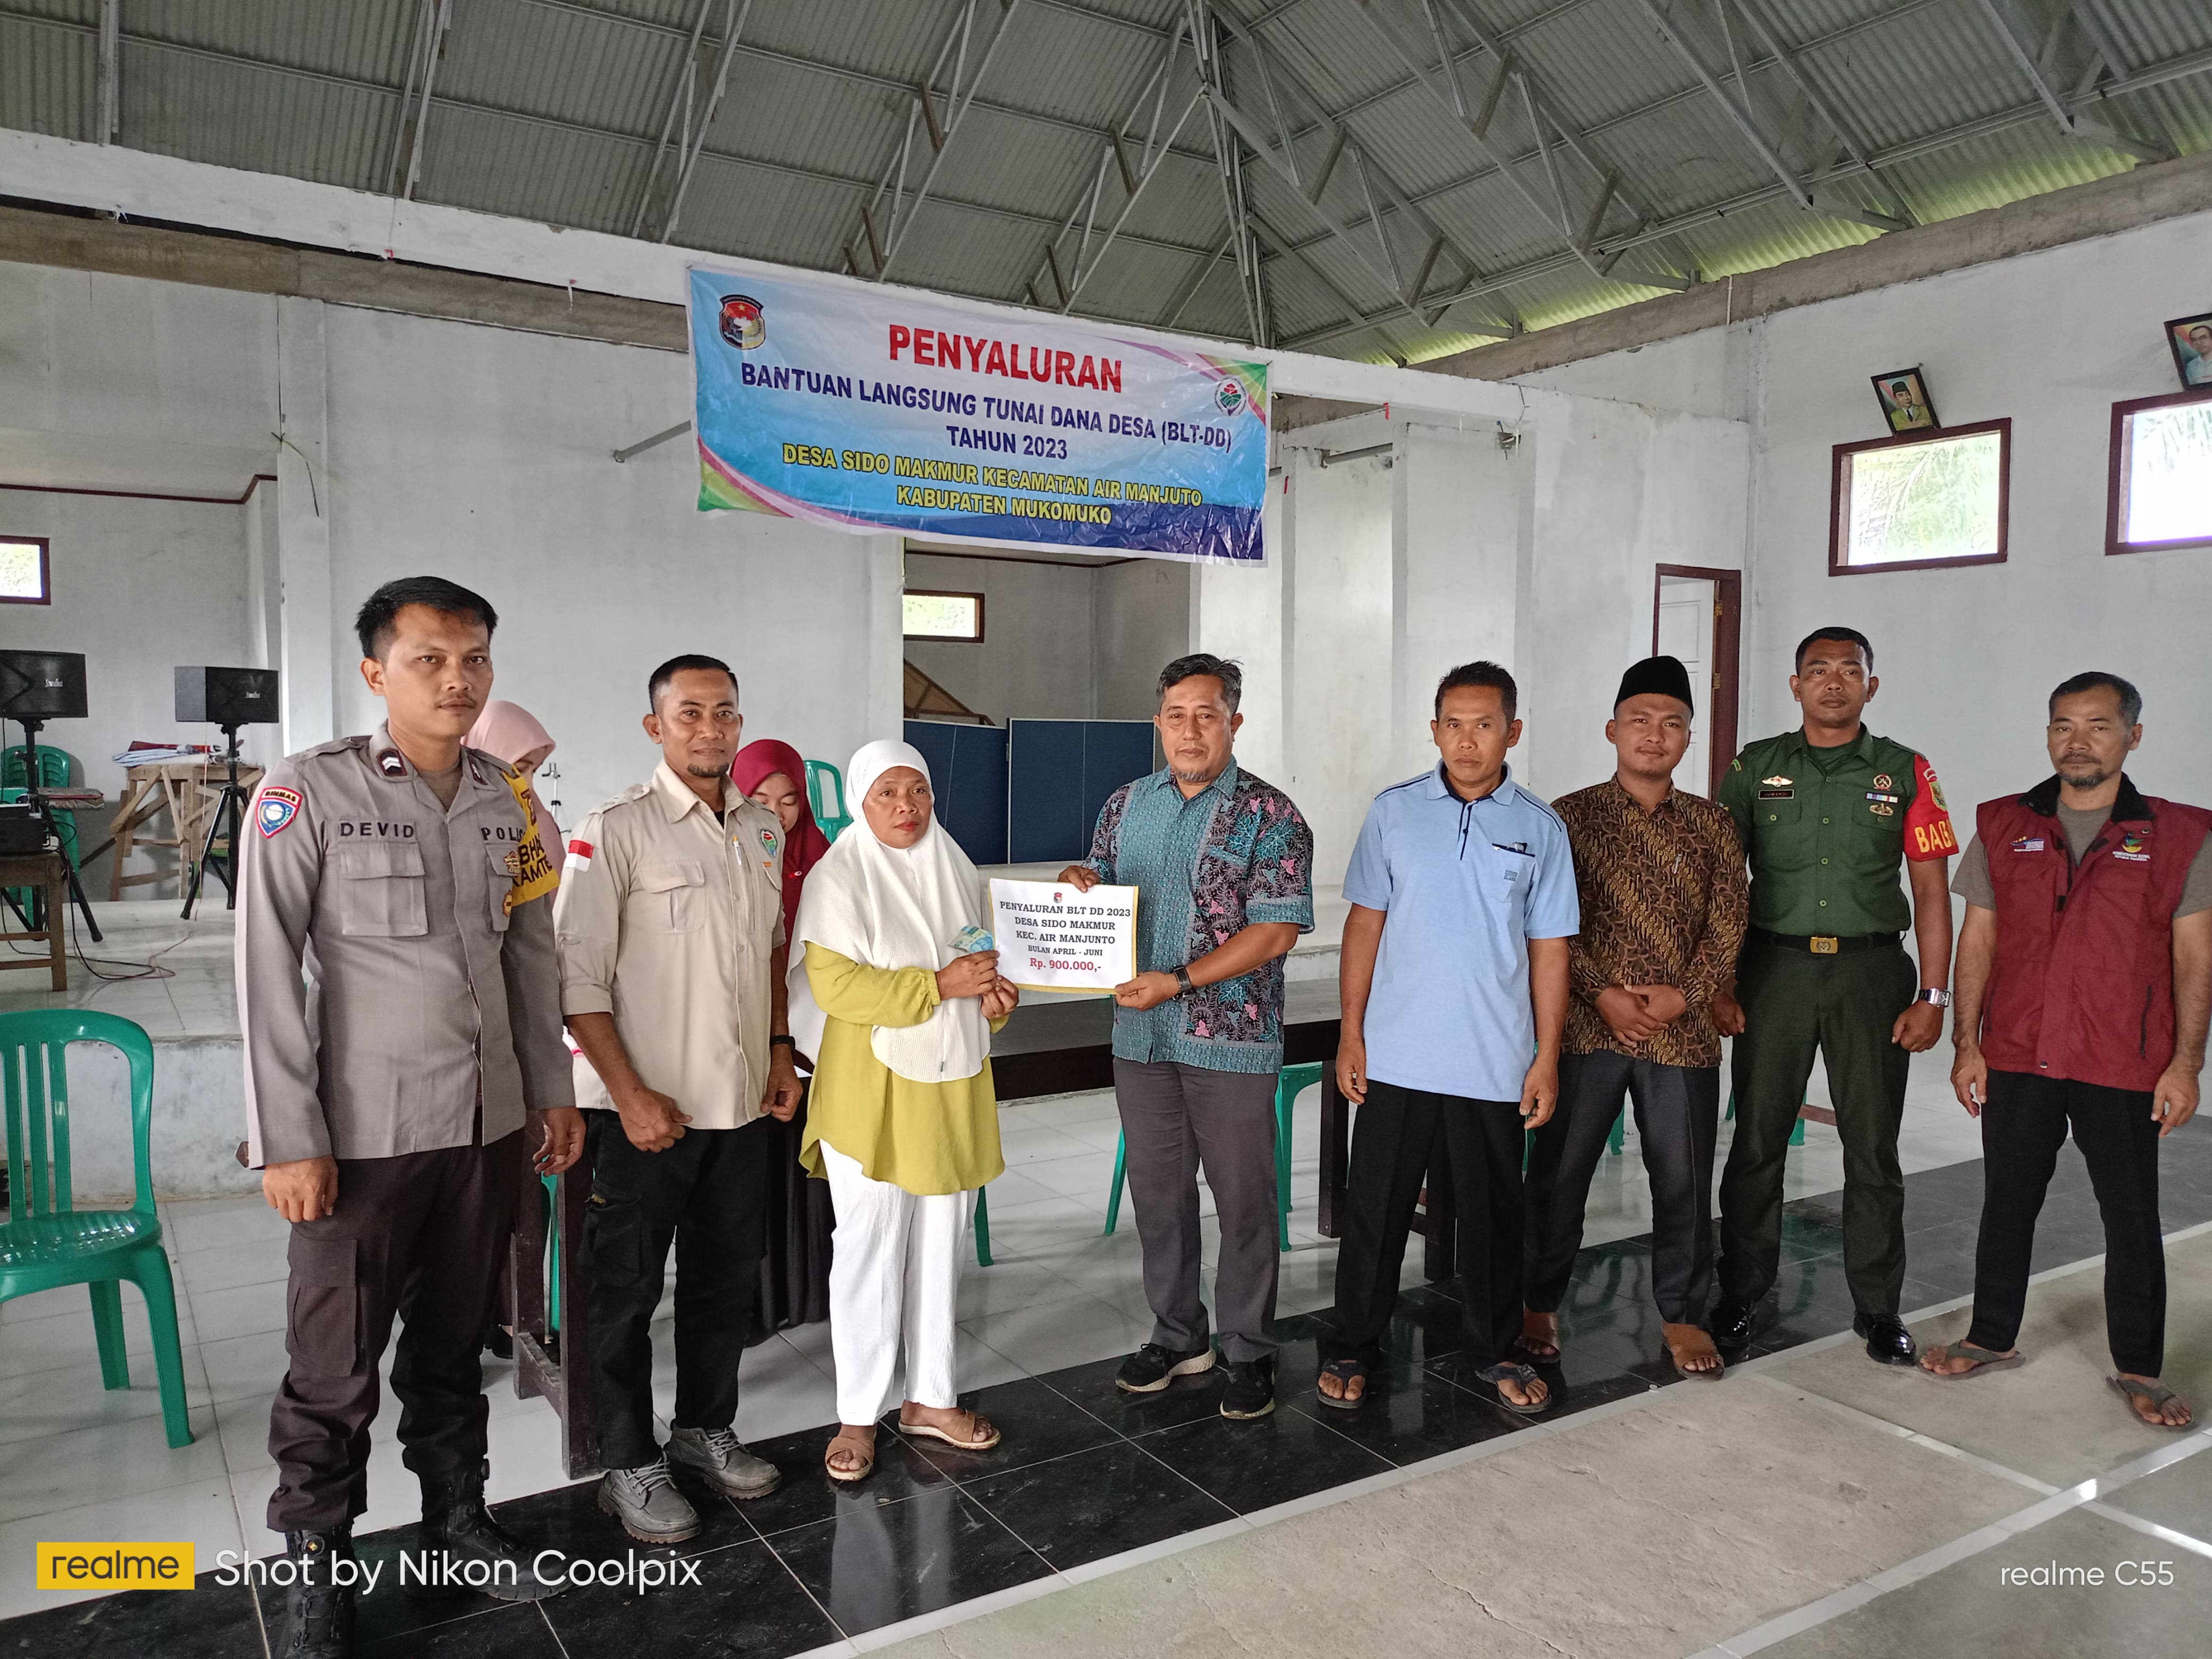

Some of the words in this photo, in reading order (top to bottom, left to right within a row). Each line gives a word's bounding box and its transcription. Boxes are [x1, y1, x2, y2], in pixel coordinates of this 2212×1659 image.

[890, 324, 1121, 393] PENYALURAN
[742, 363, 852, 398] BANTUAN
[859, 380, 976, 416] LANGSUNG
[984, 397, 1043, 424] TUNAI
[1051, 406, 1102, 432] DANA
[1109, 414, 1156, 438] DESA
[1161, 421, 1231, 453] (BLT-DD)
[946, 425, 1016, 453] TAHUN
[1023, 435, 1068, 459] 2023
[783, 443, 837, 468] DESA
[842, 450, 889, 474] SIDO
[895, 456, 978, 484] MAKMUR
[983, 467, 1088, 496] KECAMATAN
[1093, 479, 1121, 499] AIR
[1126, 483, 1203, 507] MANJUTO
[897, 485, 1007, 515] KABUPATEN
[1011, 498, 1112, 525] MUKOMUKO
[265, 791, 296, 802] BINMAS
[340, 823, 414, 838] DEVID
[1000, 901, 1063, 914] PENYALURAN
[1090, 907, 1104, 916] DD
[1107, 908, 1130, 917] 2023
[1015, 917, 1038, 926] DESA
[1041, 919, 1067, 928] SIDO
[1070, 920, 1116, 930] MAKMUR
[1016, 931, 1036, 940] KEC.
[1059, 935, 1115, 944] MANJUNTO
[1028, 945, 1050, 953] BULAN
[1029, 958, 1046, 969] Rp.
[1049, 960, 1101, 972] 900.000,-
